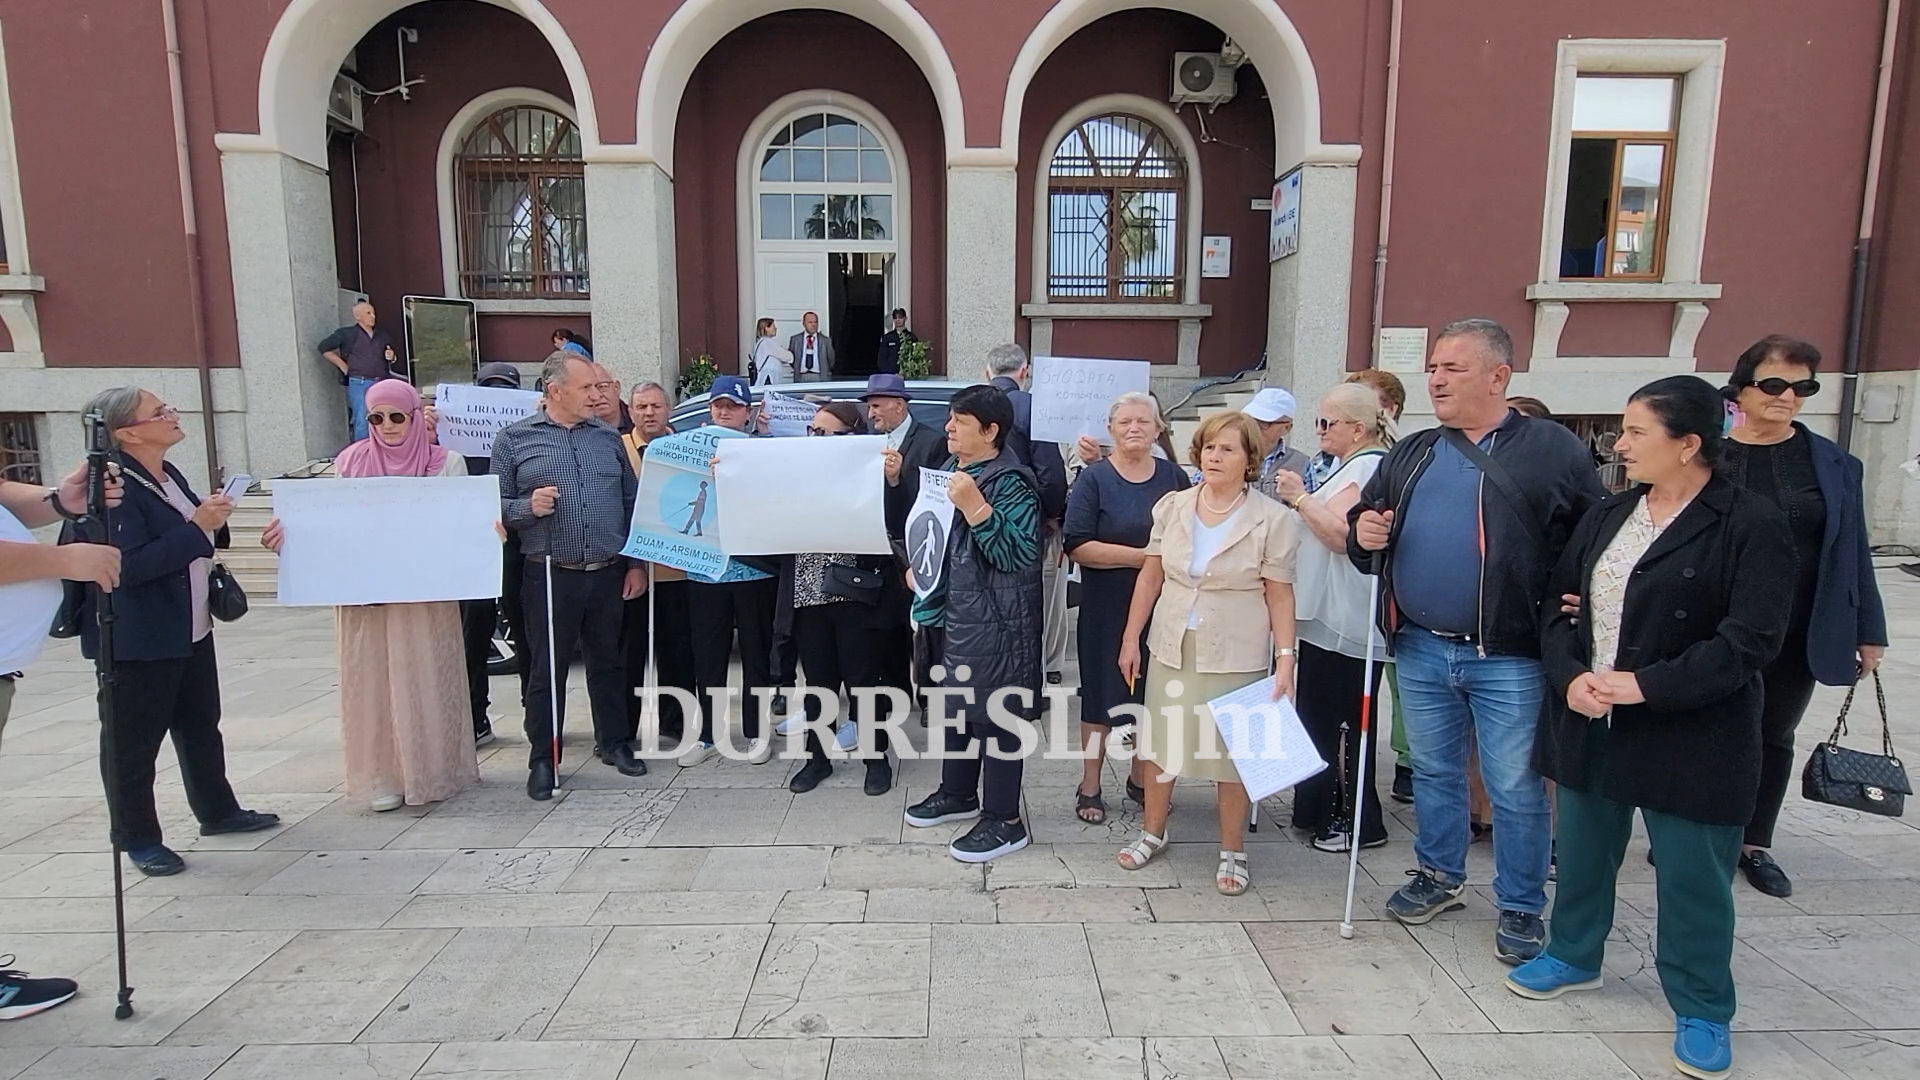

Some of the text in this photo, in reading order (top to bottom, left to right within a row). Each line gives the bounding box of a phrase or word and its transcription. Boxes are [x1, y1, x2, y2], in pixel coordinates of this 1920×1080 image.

[1041, 364, 1116, 386] SHOQATA
[467, 405, 527, 416] LIRIA JOTE
[445, 416, 492, 426] MBARON
[664, 442, 681, 452] DITA
[931, 474, 952, 488] TETO
[636, 536, 664, 549] DUAM
[670, 545, 700, 558] ARSIM
[702, 552, 723, 563] DHE
